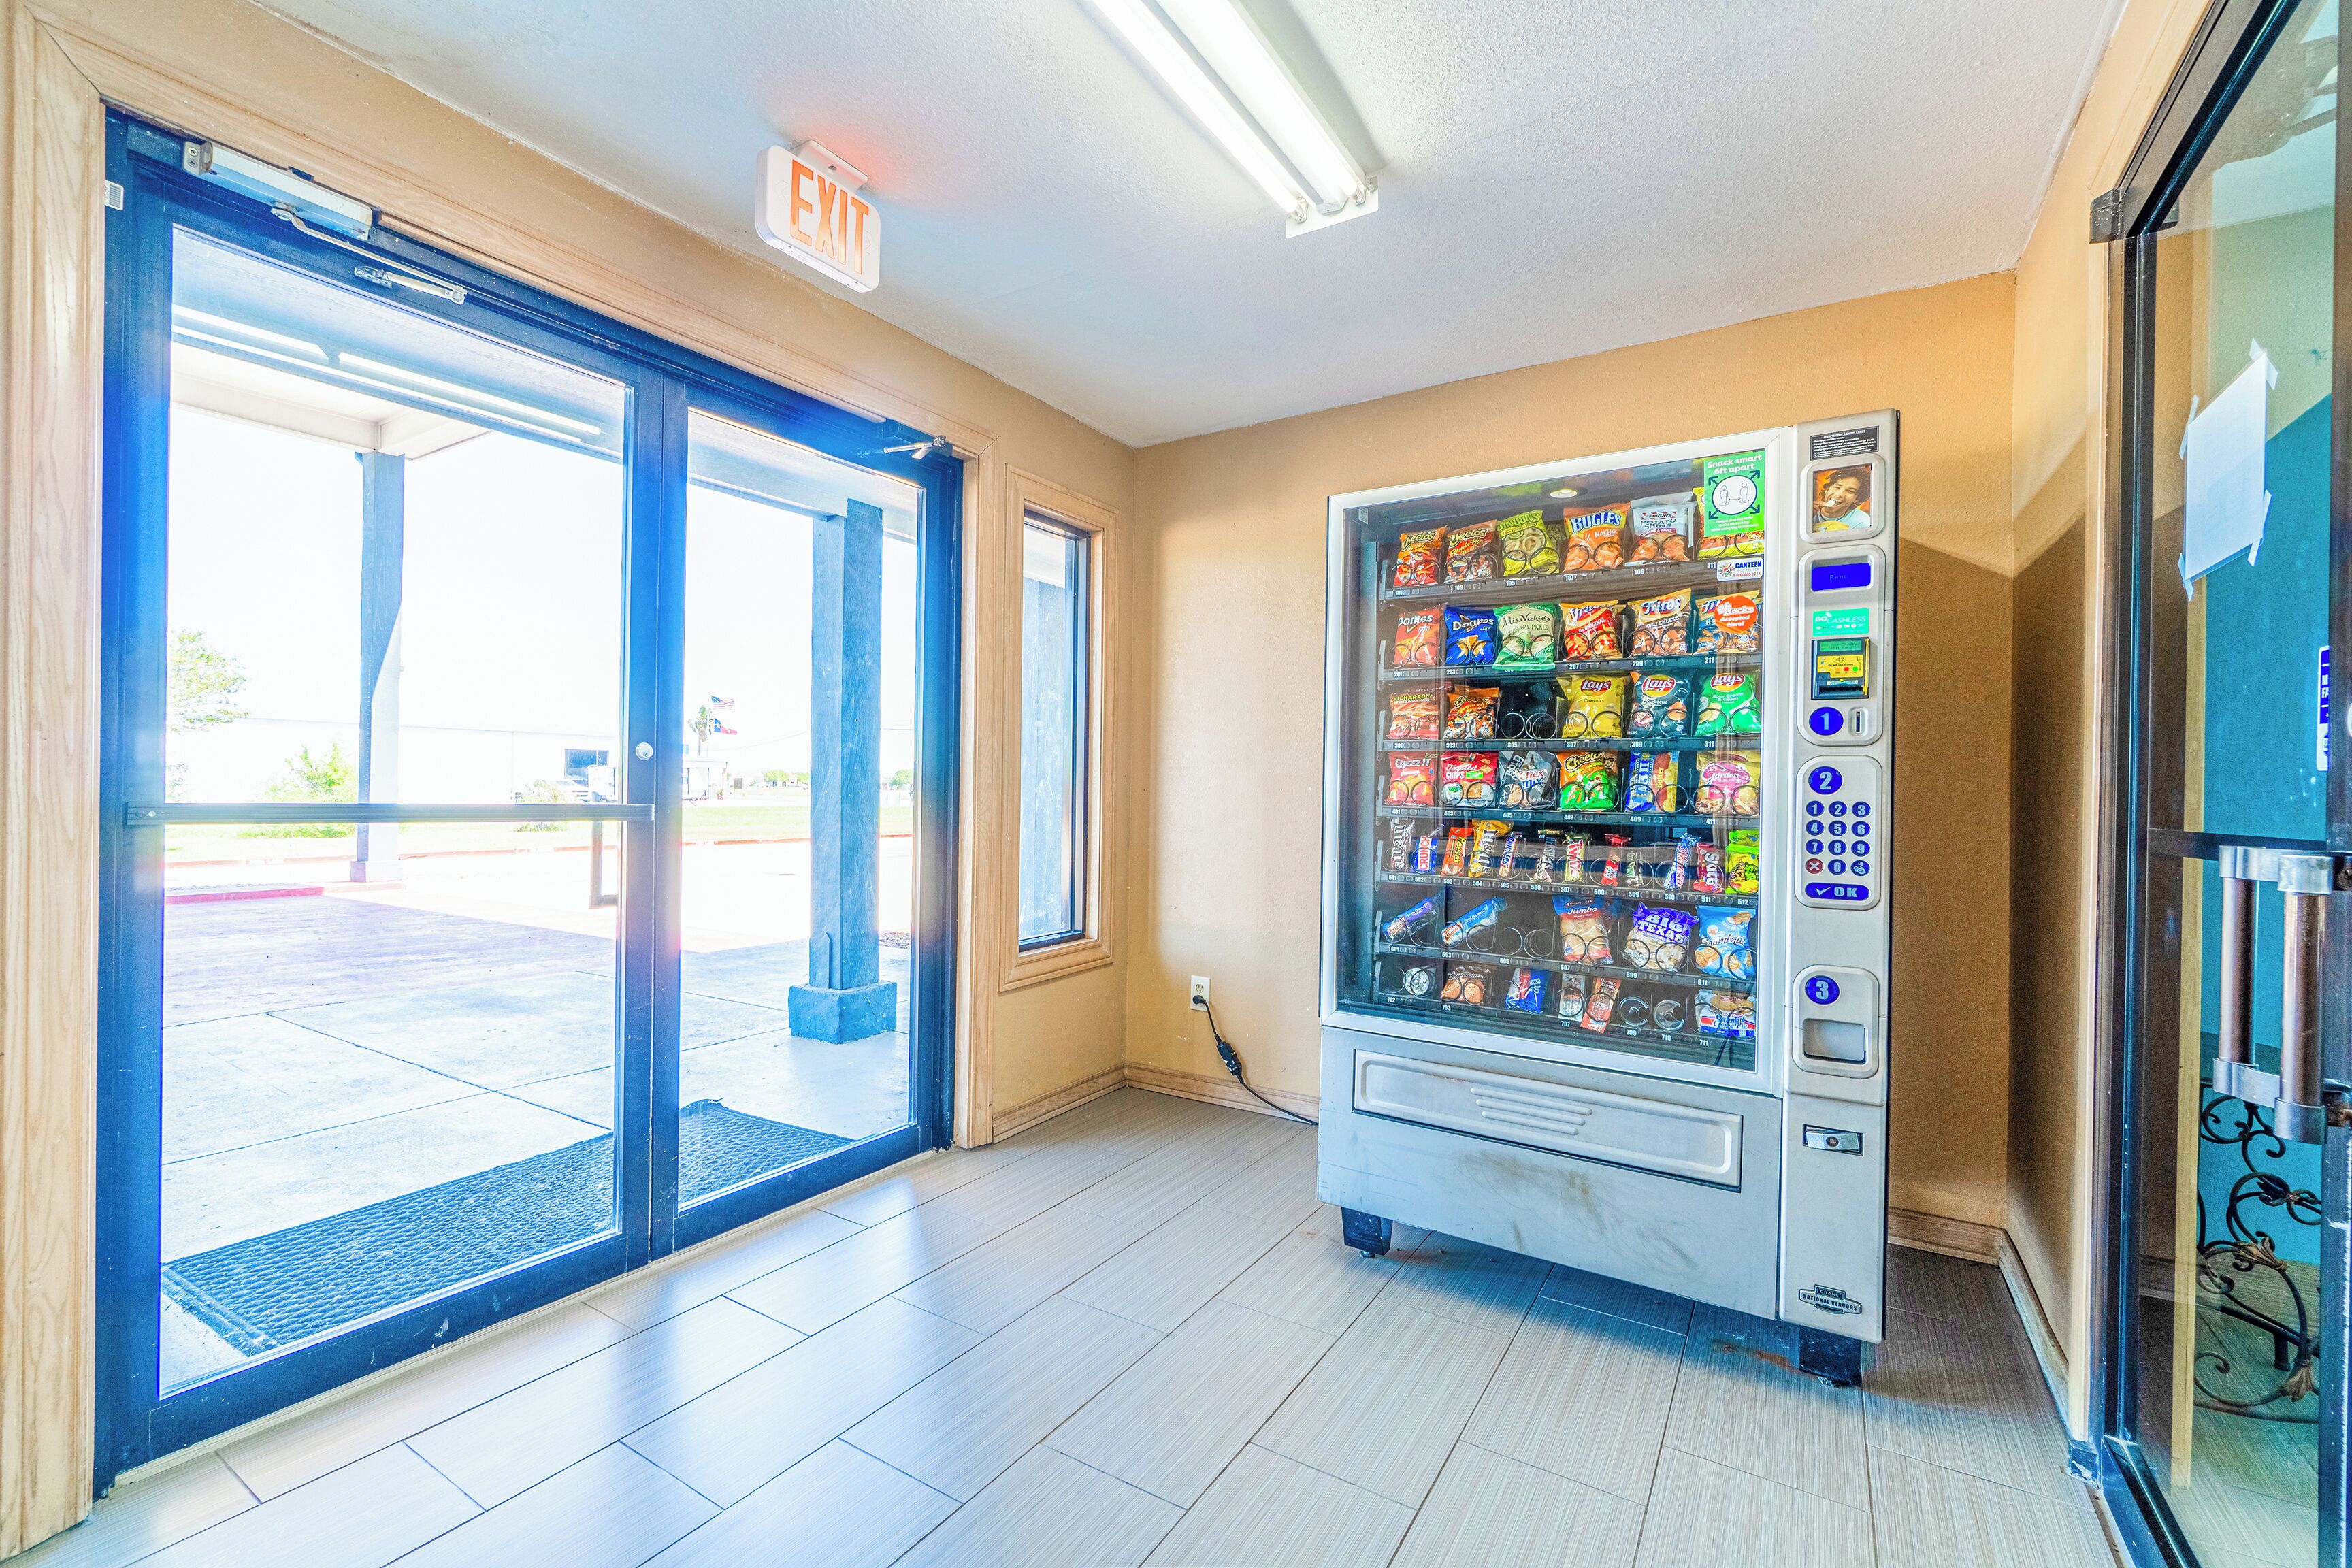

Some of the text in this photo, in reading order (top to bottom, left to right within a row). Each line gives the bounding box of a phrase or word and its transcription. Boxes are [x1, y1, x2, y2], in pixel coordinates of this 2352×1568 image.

[790, 159, 869, 274] EXIT
[1707, 454, 1763, 469] Snack smart
[1729, 463, 1755, 474] apart
[1569, 511, 1622, 533] BUGLES
[1641, 518, 1677, 526] POTATO
[1449, 528, 1488, 549] Cheetos
[1595, 529, 1616, 538] NACHO
[1641, 598, 1682, 615] Fritos
[1502, 616, 1522, 629] Miss
[1519, 612, 1551, 623] Vickie's
[1584, 617, 1606, 631] ORIGINAL
[1659, 615, 1680, 626] CHEESE
[1815, 615, 1867, 624] GO CASHLESS
[1582, 680, 1611, 692] Lay's
[1644, 679, 1674, 692] Lay's
[1712, 674, 1743, 687] Lay's
[1820, 712, 1829, 730] 1
[1505, 755, 1521, 777] BOLD
[1519, 769, 1545, 780] Chex
[1654, 766, 1664, 789] Butter
[1820, 772, 1832, 790] 2
[1812, 804, 1865, 815] 1 2 3
[1810, 823, 1865, 835] 4 5 6
[1419, 836, 1430, 870] CRUNCH
[1812, 842, 1865, 854] 7 8 9
[1833, 862, 1841, 872] 0
[1834, 887, 1858, 898] OK
[1567, 906, 1598, 915] Jumbo
[1644, 913, 1684, 933] BIG
[1637, 920, 1685, 944] TEXAS
[1815, 981, 1829, 1000] 3
[1820, 1290, 1842, 1299] CRANE
[1803, 1294, 1857, 1311] NATIONAL VENDORS
